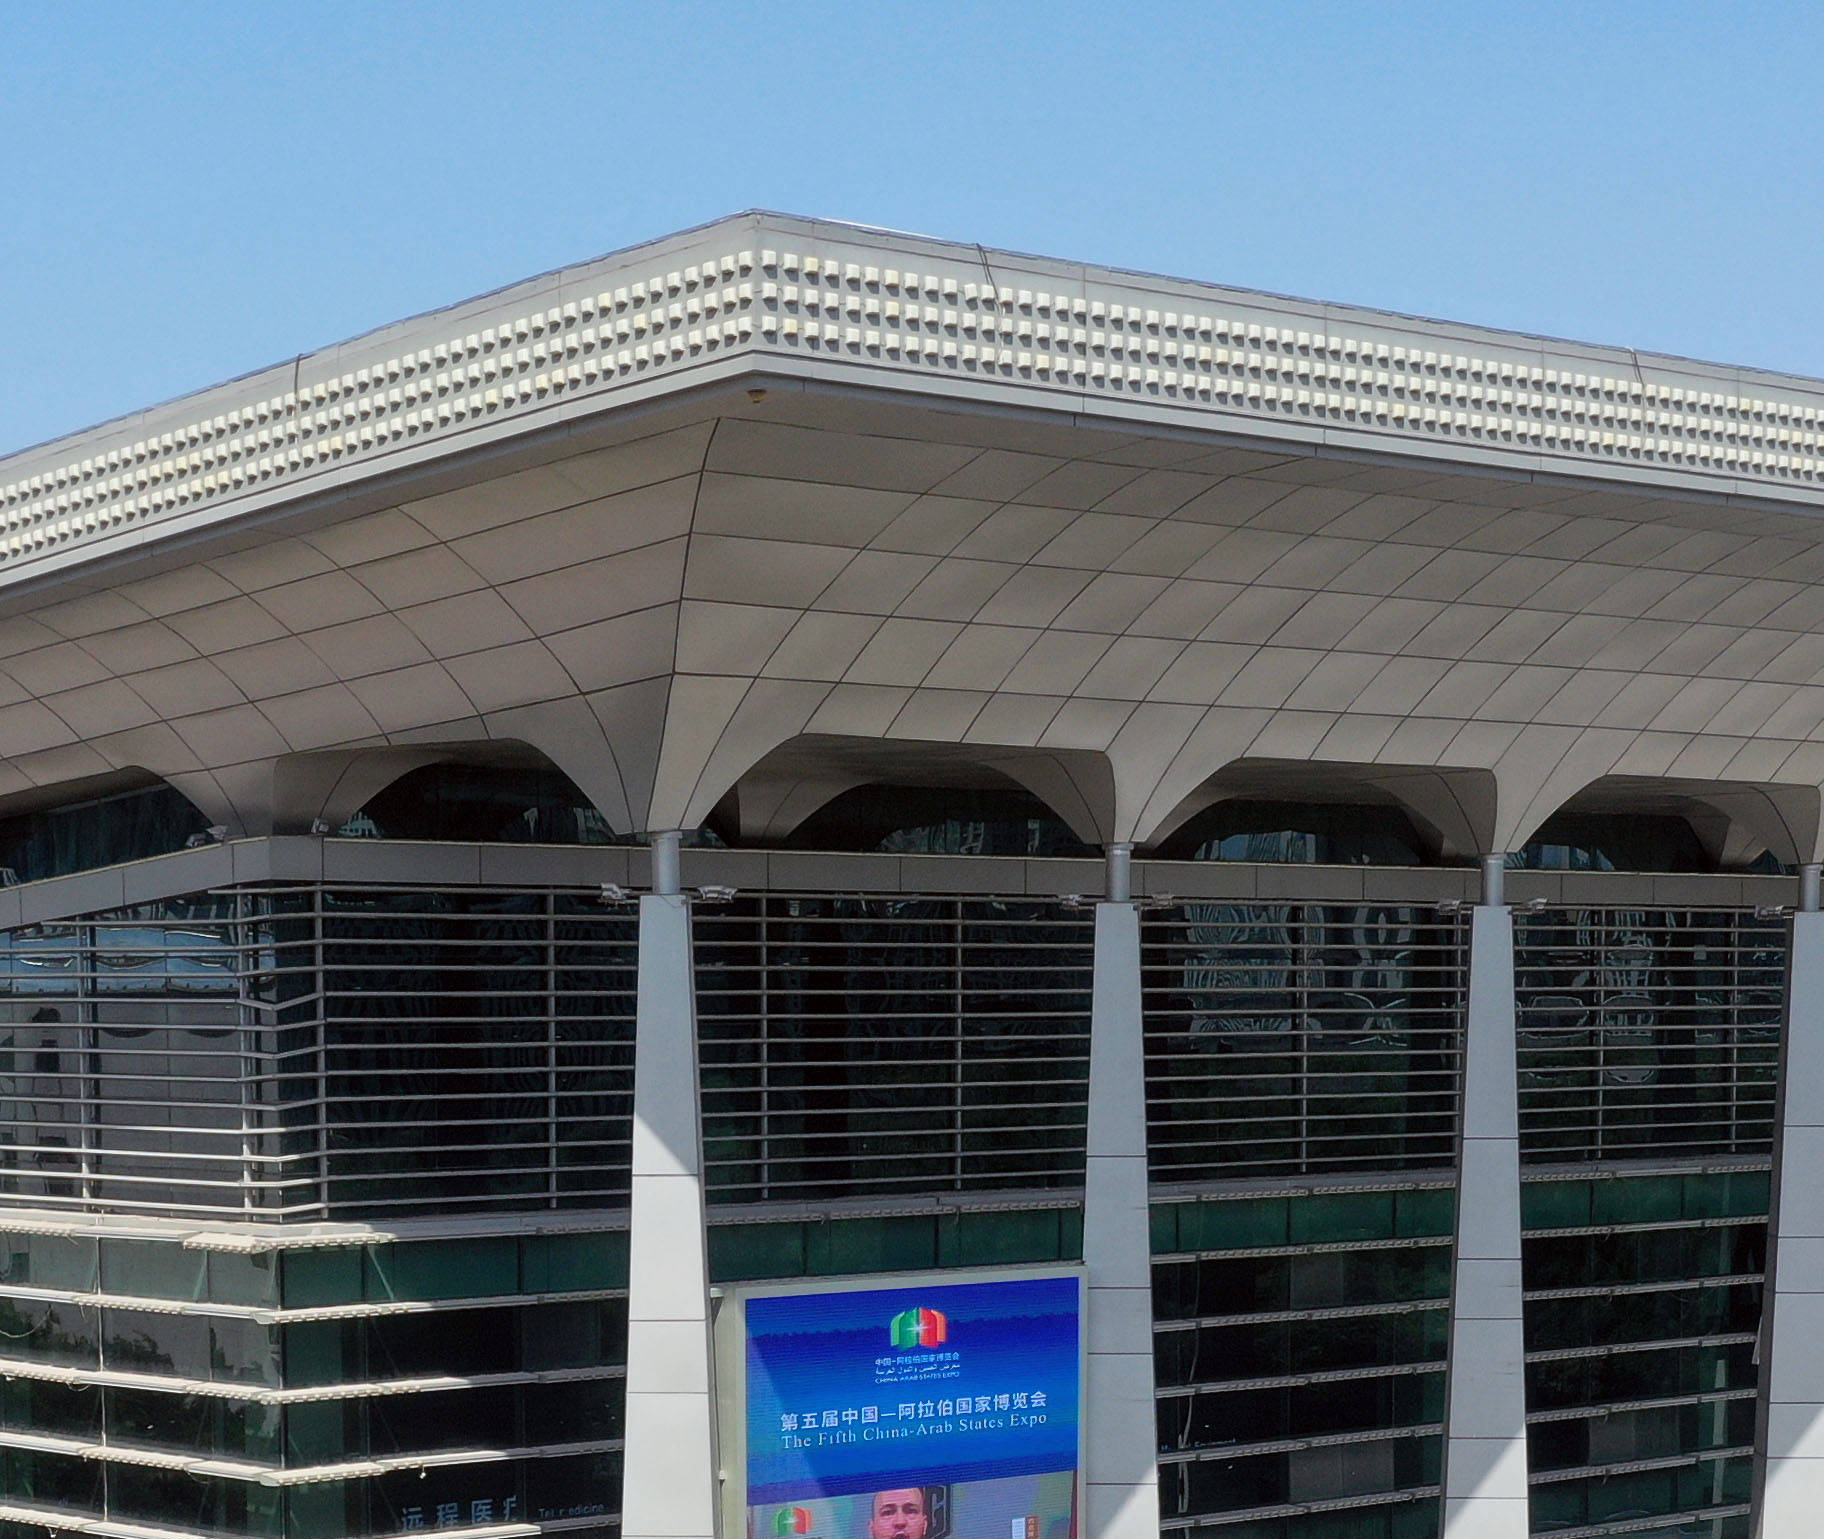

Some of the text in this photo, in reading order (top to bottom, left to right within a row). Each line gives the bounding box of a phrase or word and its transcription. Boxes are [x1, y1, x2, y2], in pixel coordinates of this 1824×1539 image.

[781, 1413, 1047, 1449] The Fifth China-Arab States Expo
